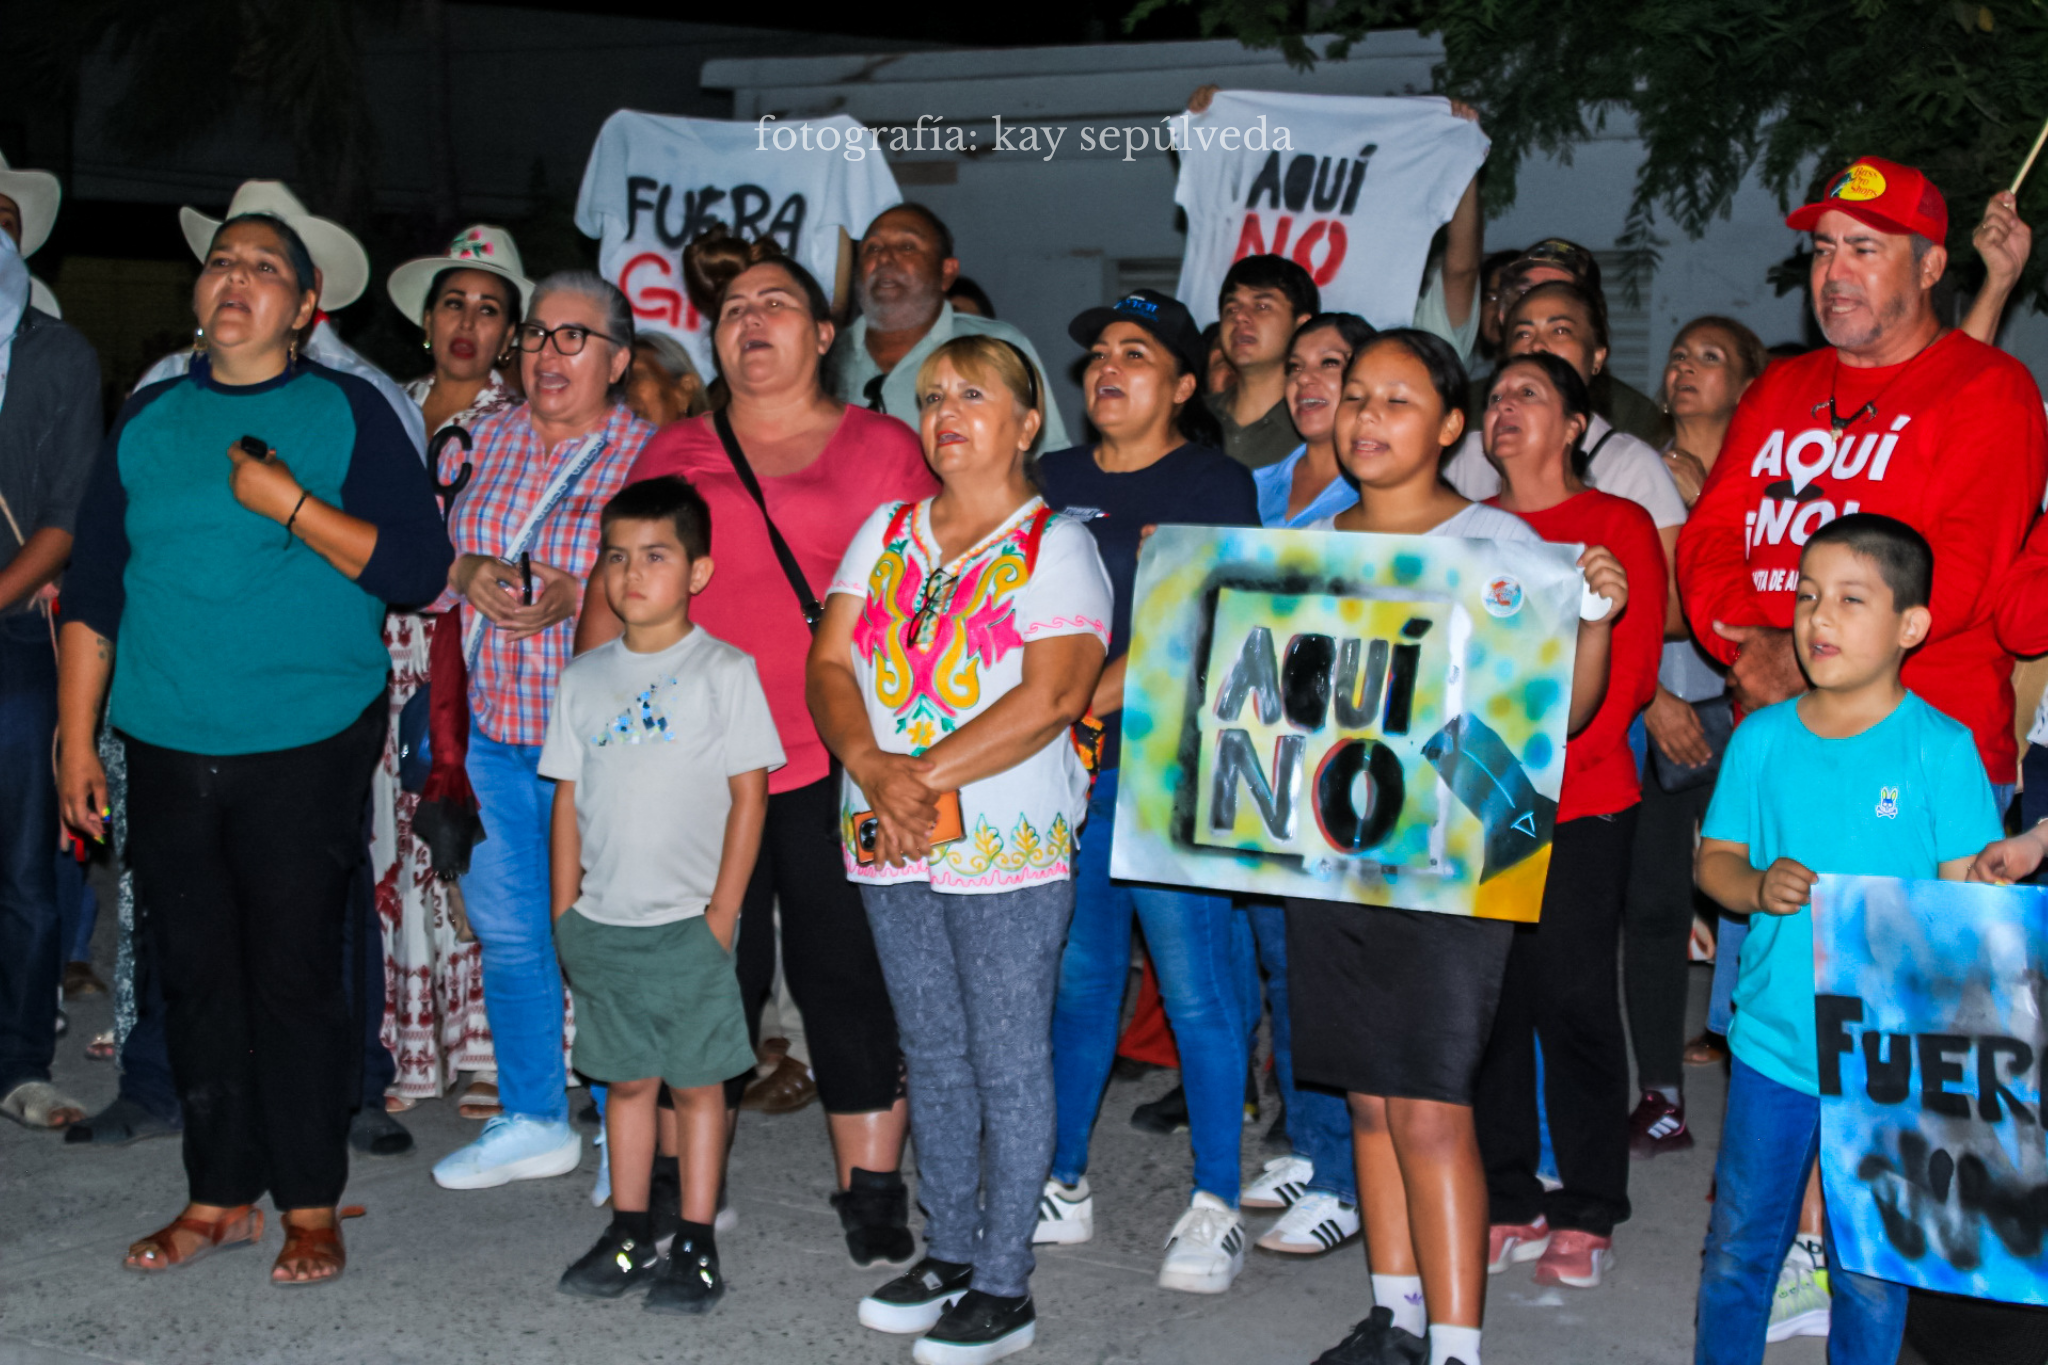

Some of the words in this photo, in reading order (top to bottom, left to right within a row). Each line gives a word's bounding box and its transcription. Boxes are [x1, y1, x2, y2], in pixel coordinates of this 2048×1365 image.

[624, 176, 806, 260] FUERA
[1231, 212, 1348, 288] NO
[1751, 414, 1912, 496] AQUÍ
[1213, 617, 1433, 735] AQUÍ
[1210, 728, 1406, 855] NO
[1816, 993, 2048, 1126] FUER
